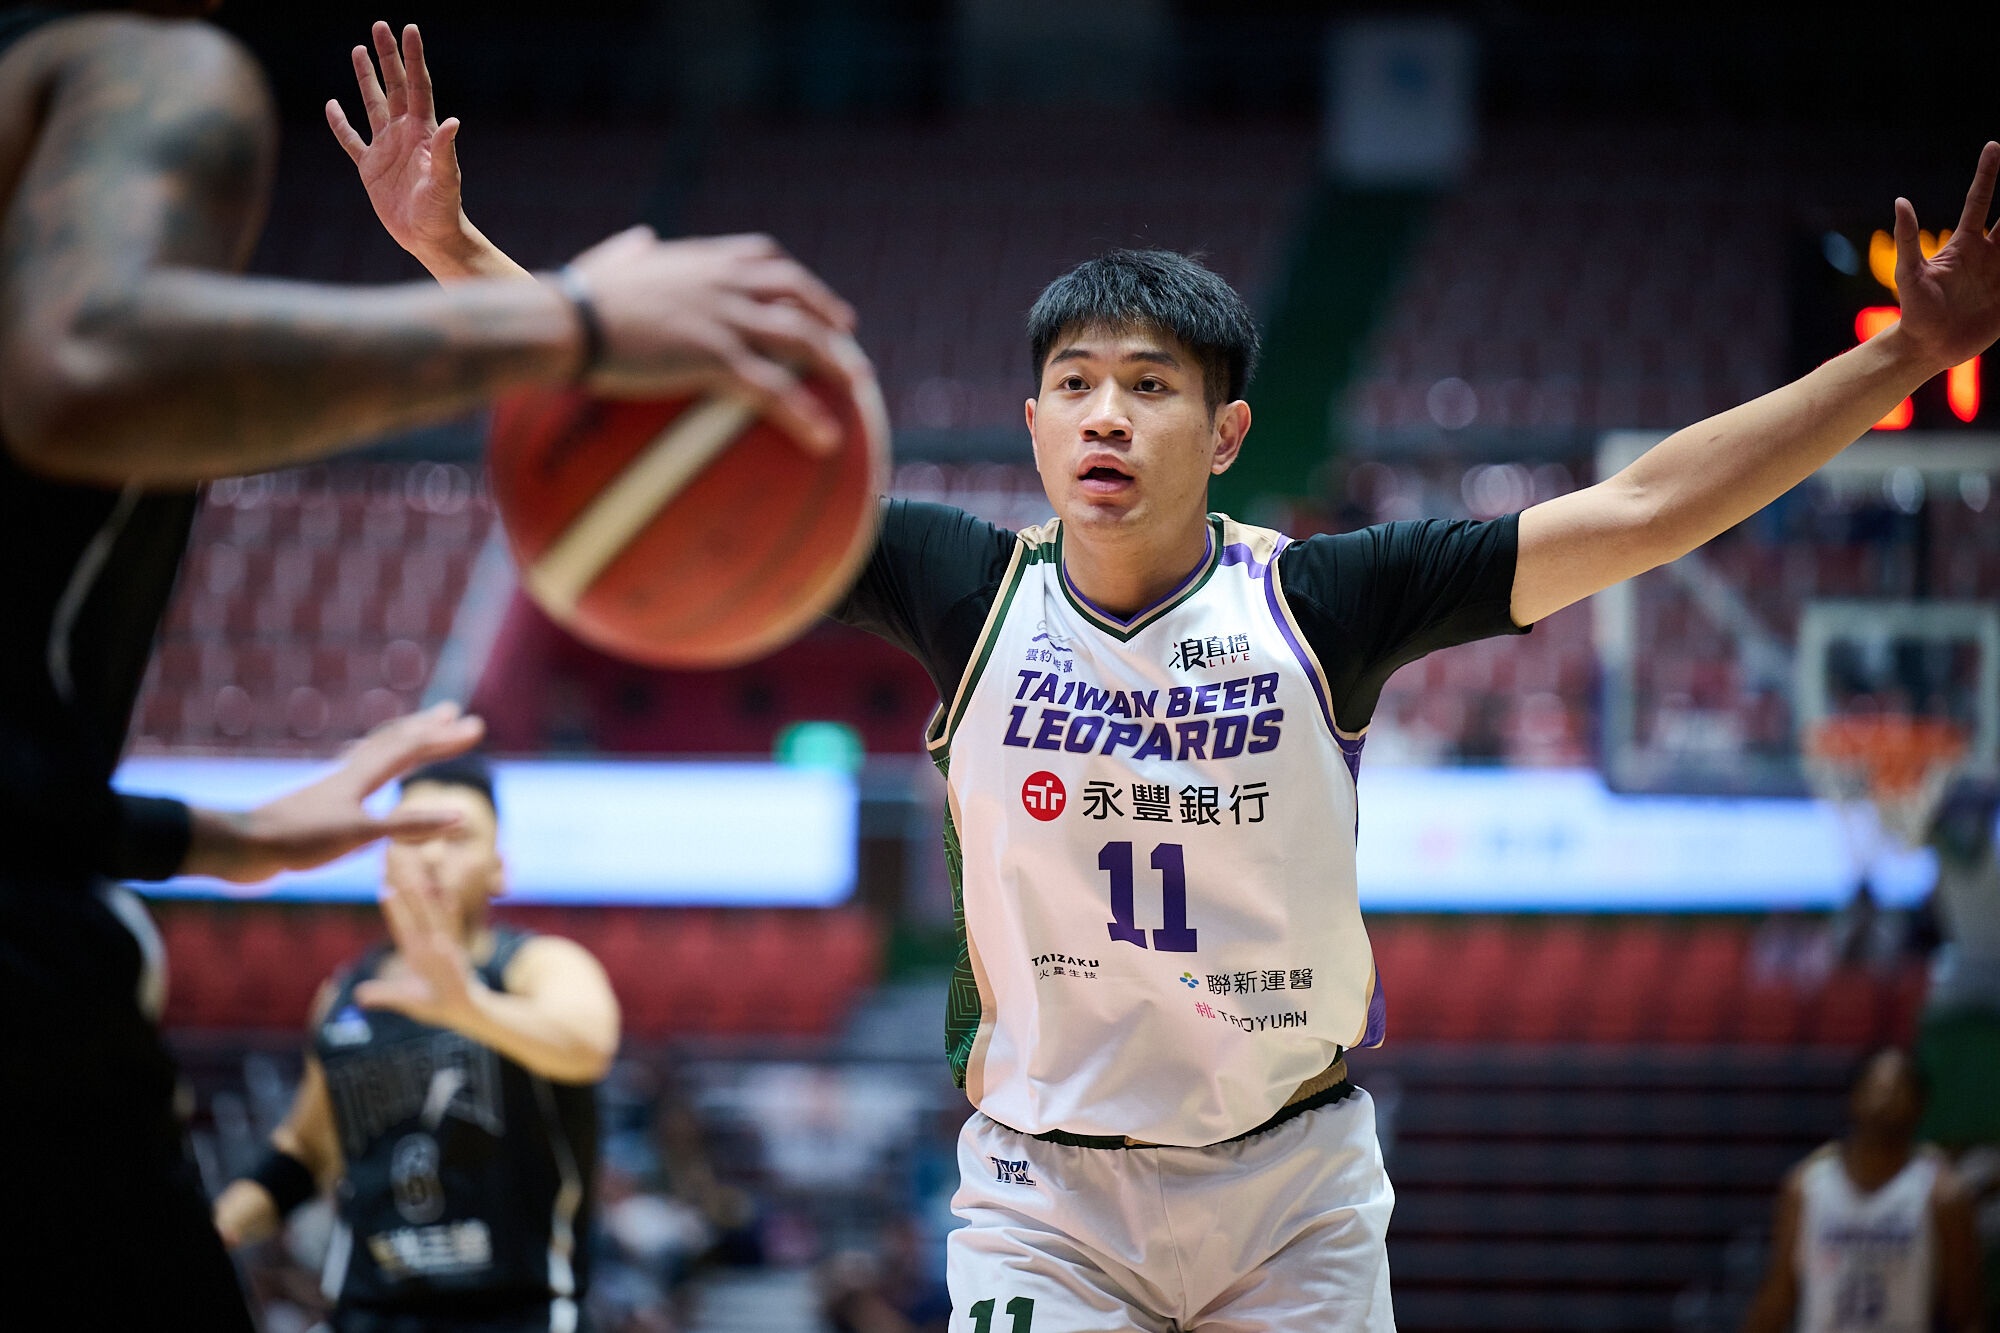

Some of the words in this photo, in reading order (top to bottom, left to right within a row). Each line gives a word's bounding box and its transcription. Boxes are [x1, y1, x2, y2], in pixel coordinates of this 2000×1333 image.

[1168, 633, 1250, 672] 浪直播
[1208, 652, 1250, 668] LIVE
[1014, 669, 1159, 719] TAIWAN
[1165, 671, 1280, 719] BEER
[1002, 704, 1285, 761] LEOPARDS
[1082, 780, 1270, 826] 永豐銀行
[1098, 841, 1198, 953] 11
[1031, 953, 1100, 968] TAIZAKU
[1039, 966, 1098, 980] 火星生技
[1206, 968, 1313, 996] 聯新運醫
[1217, 1010, 1307, 1033] TAOYUAN
